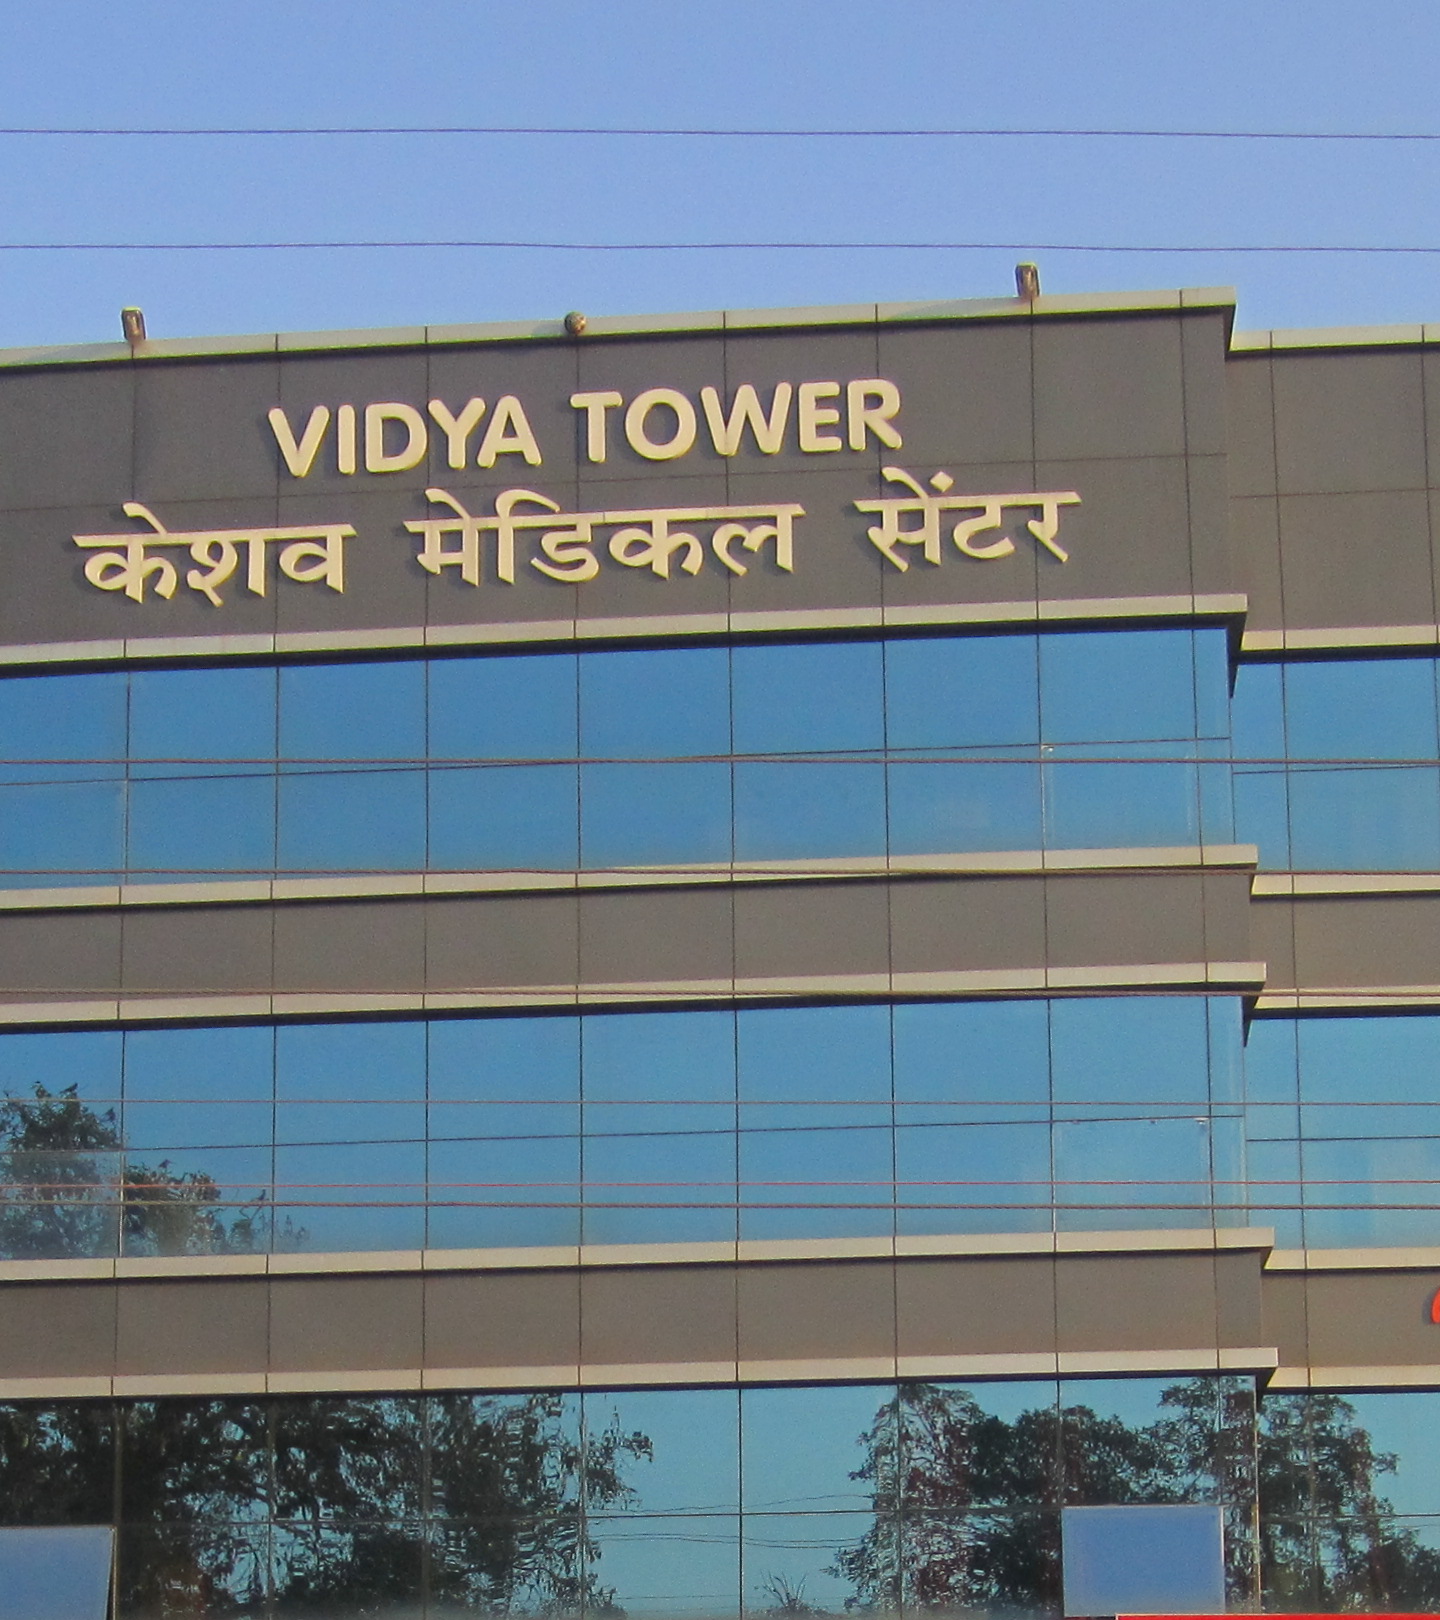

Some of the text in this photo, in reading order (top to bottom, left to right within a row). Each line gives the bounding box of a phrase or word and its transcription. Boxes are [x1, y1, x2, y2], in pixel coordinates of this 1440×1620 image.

[269, 379, 902, 478] VIDYA TOWER
[73, 467, 1082, 606] केशव मेडिकल सेंटर
